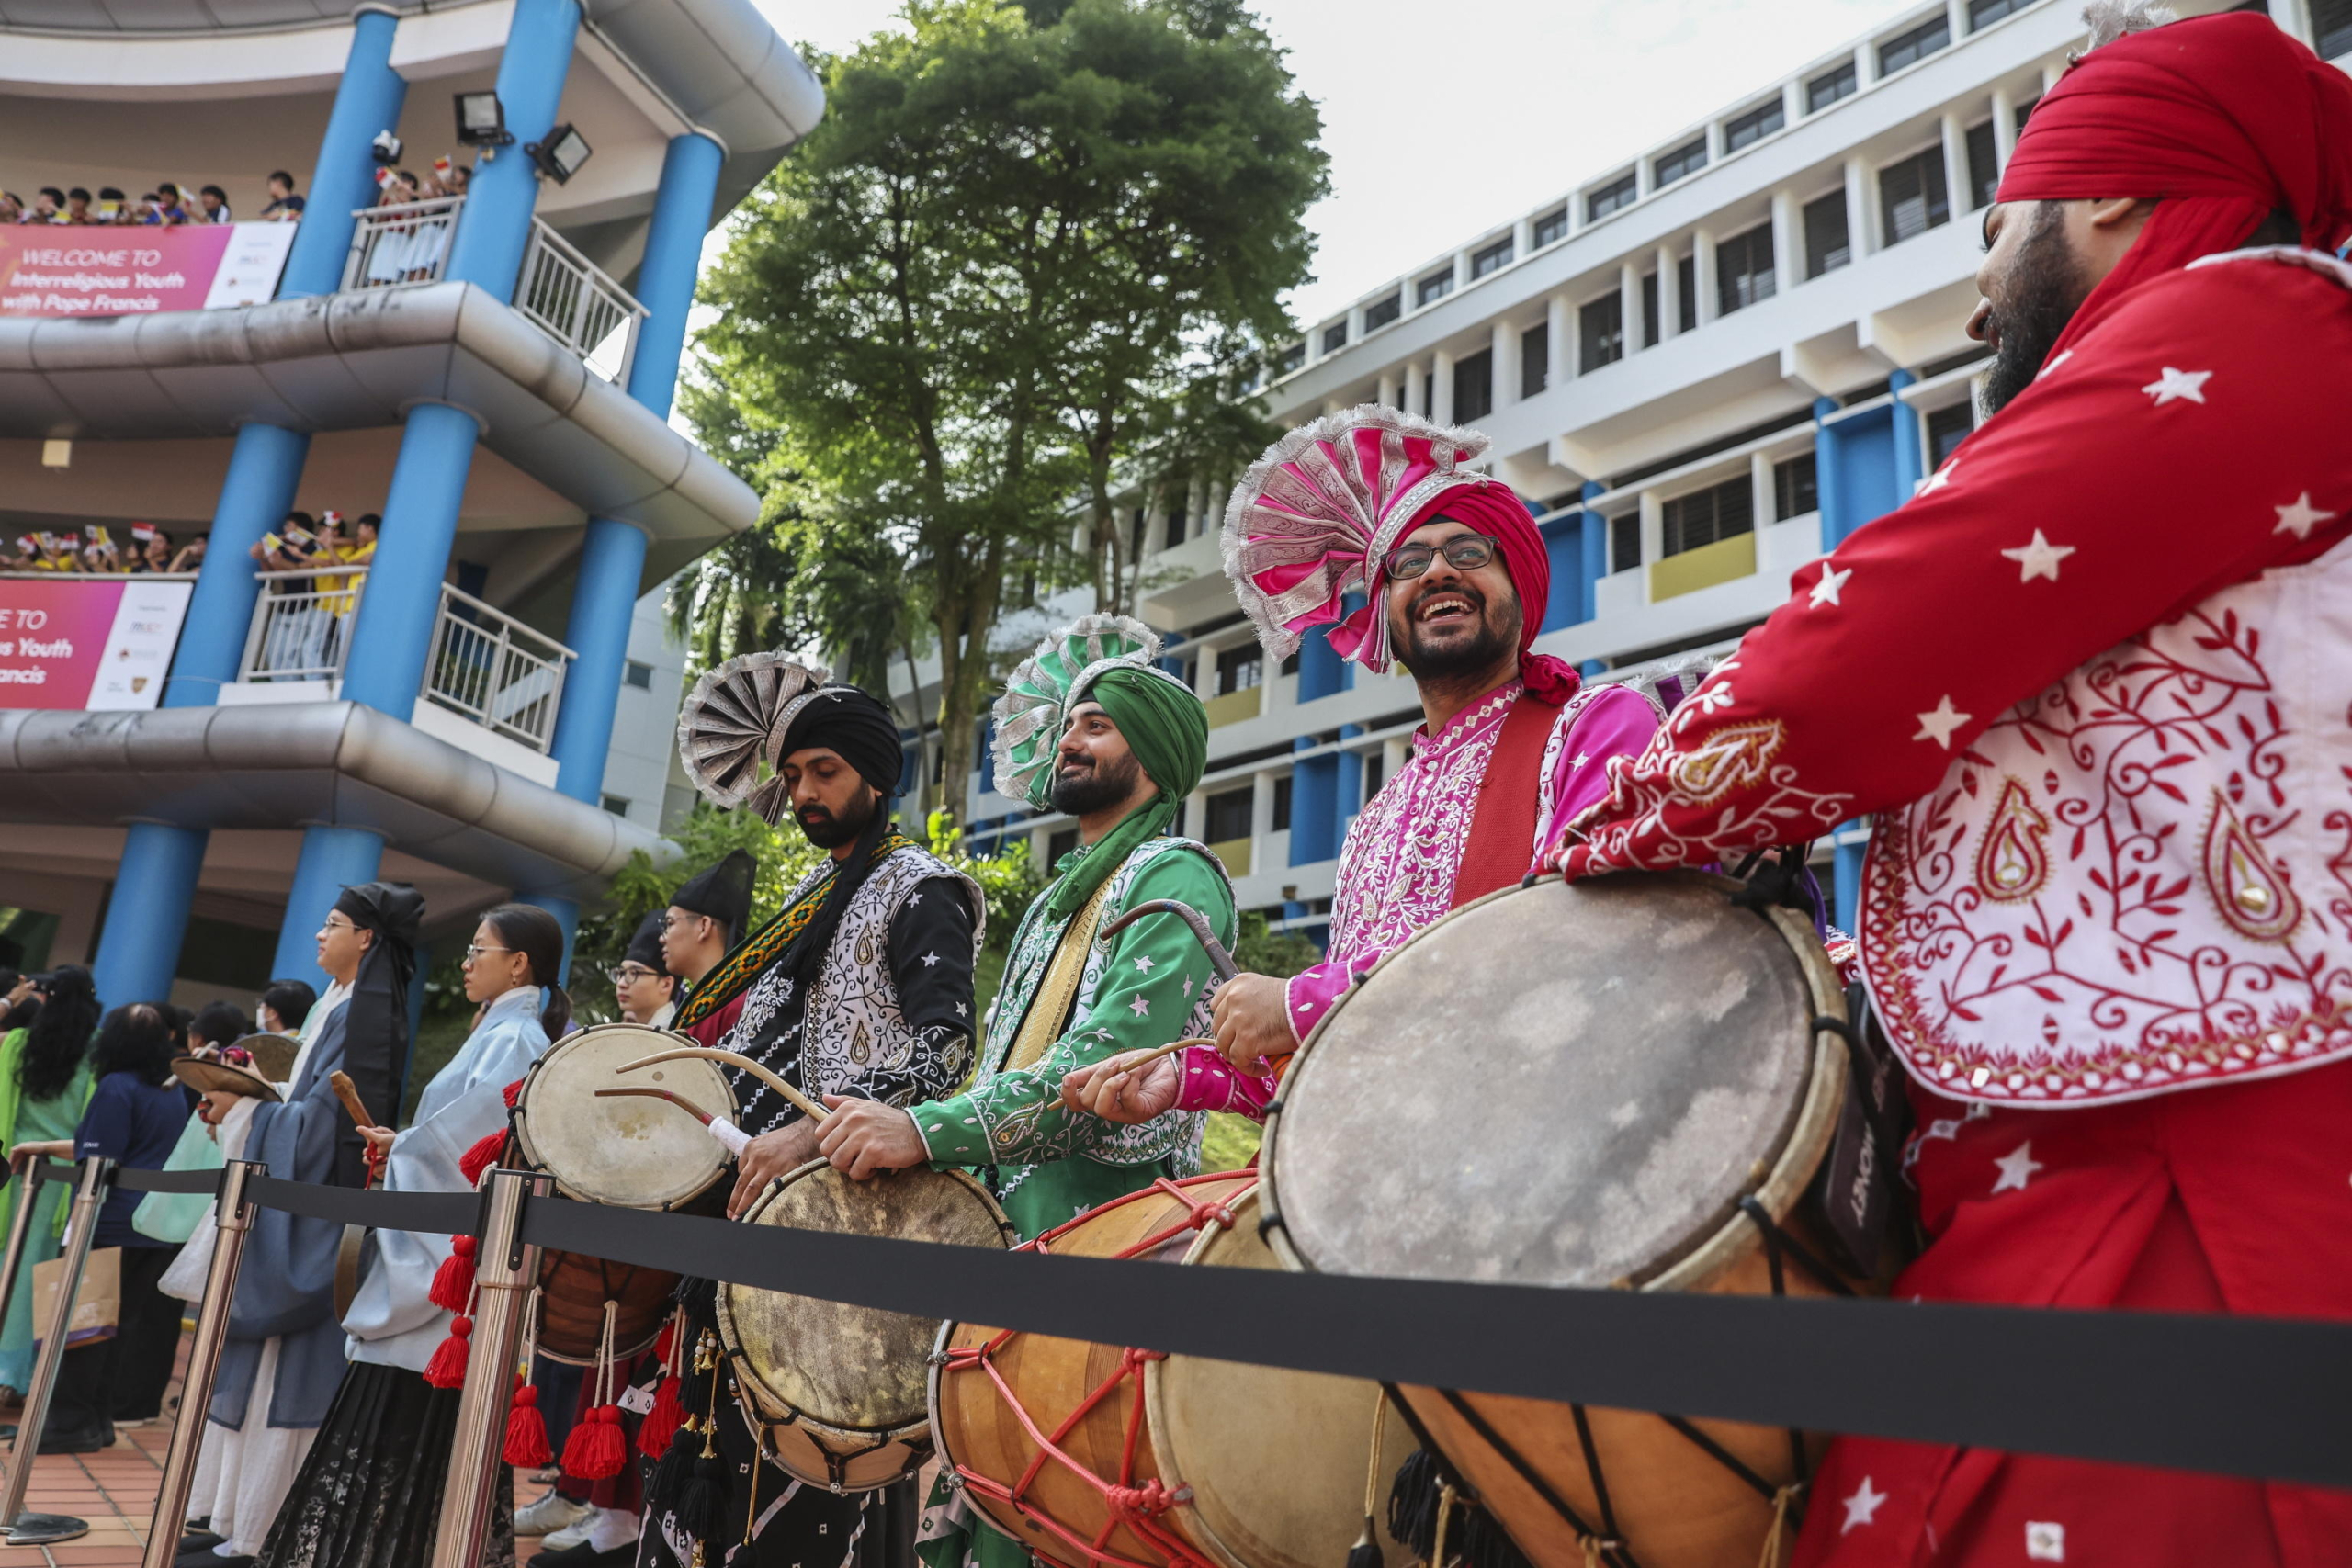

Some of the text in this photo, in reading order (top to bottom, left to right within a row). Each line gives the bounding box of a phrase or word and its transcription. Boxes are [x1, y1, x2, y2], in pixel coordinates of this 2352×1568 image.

[22, 248, 162, 267] WELCOME TO
[10, 271, 186, 292] Interreligious Youth
[1, 293, 160, 312] with Pope Francis
[16, 609, 48, 630] TO
[18, 637, 74, 659] Youth
